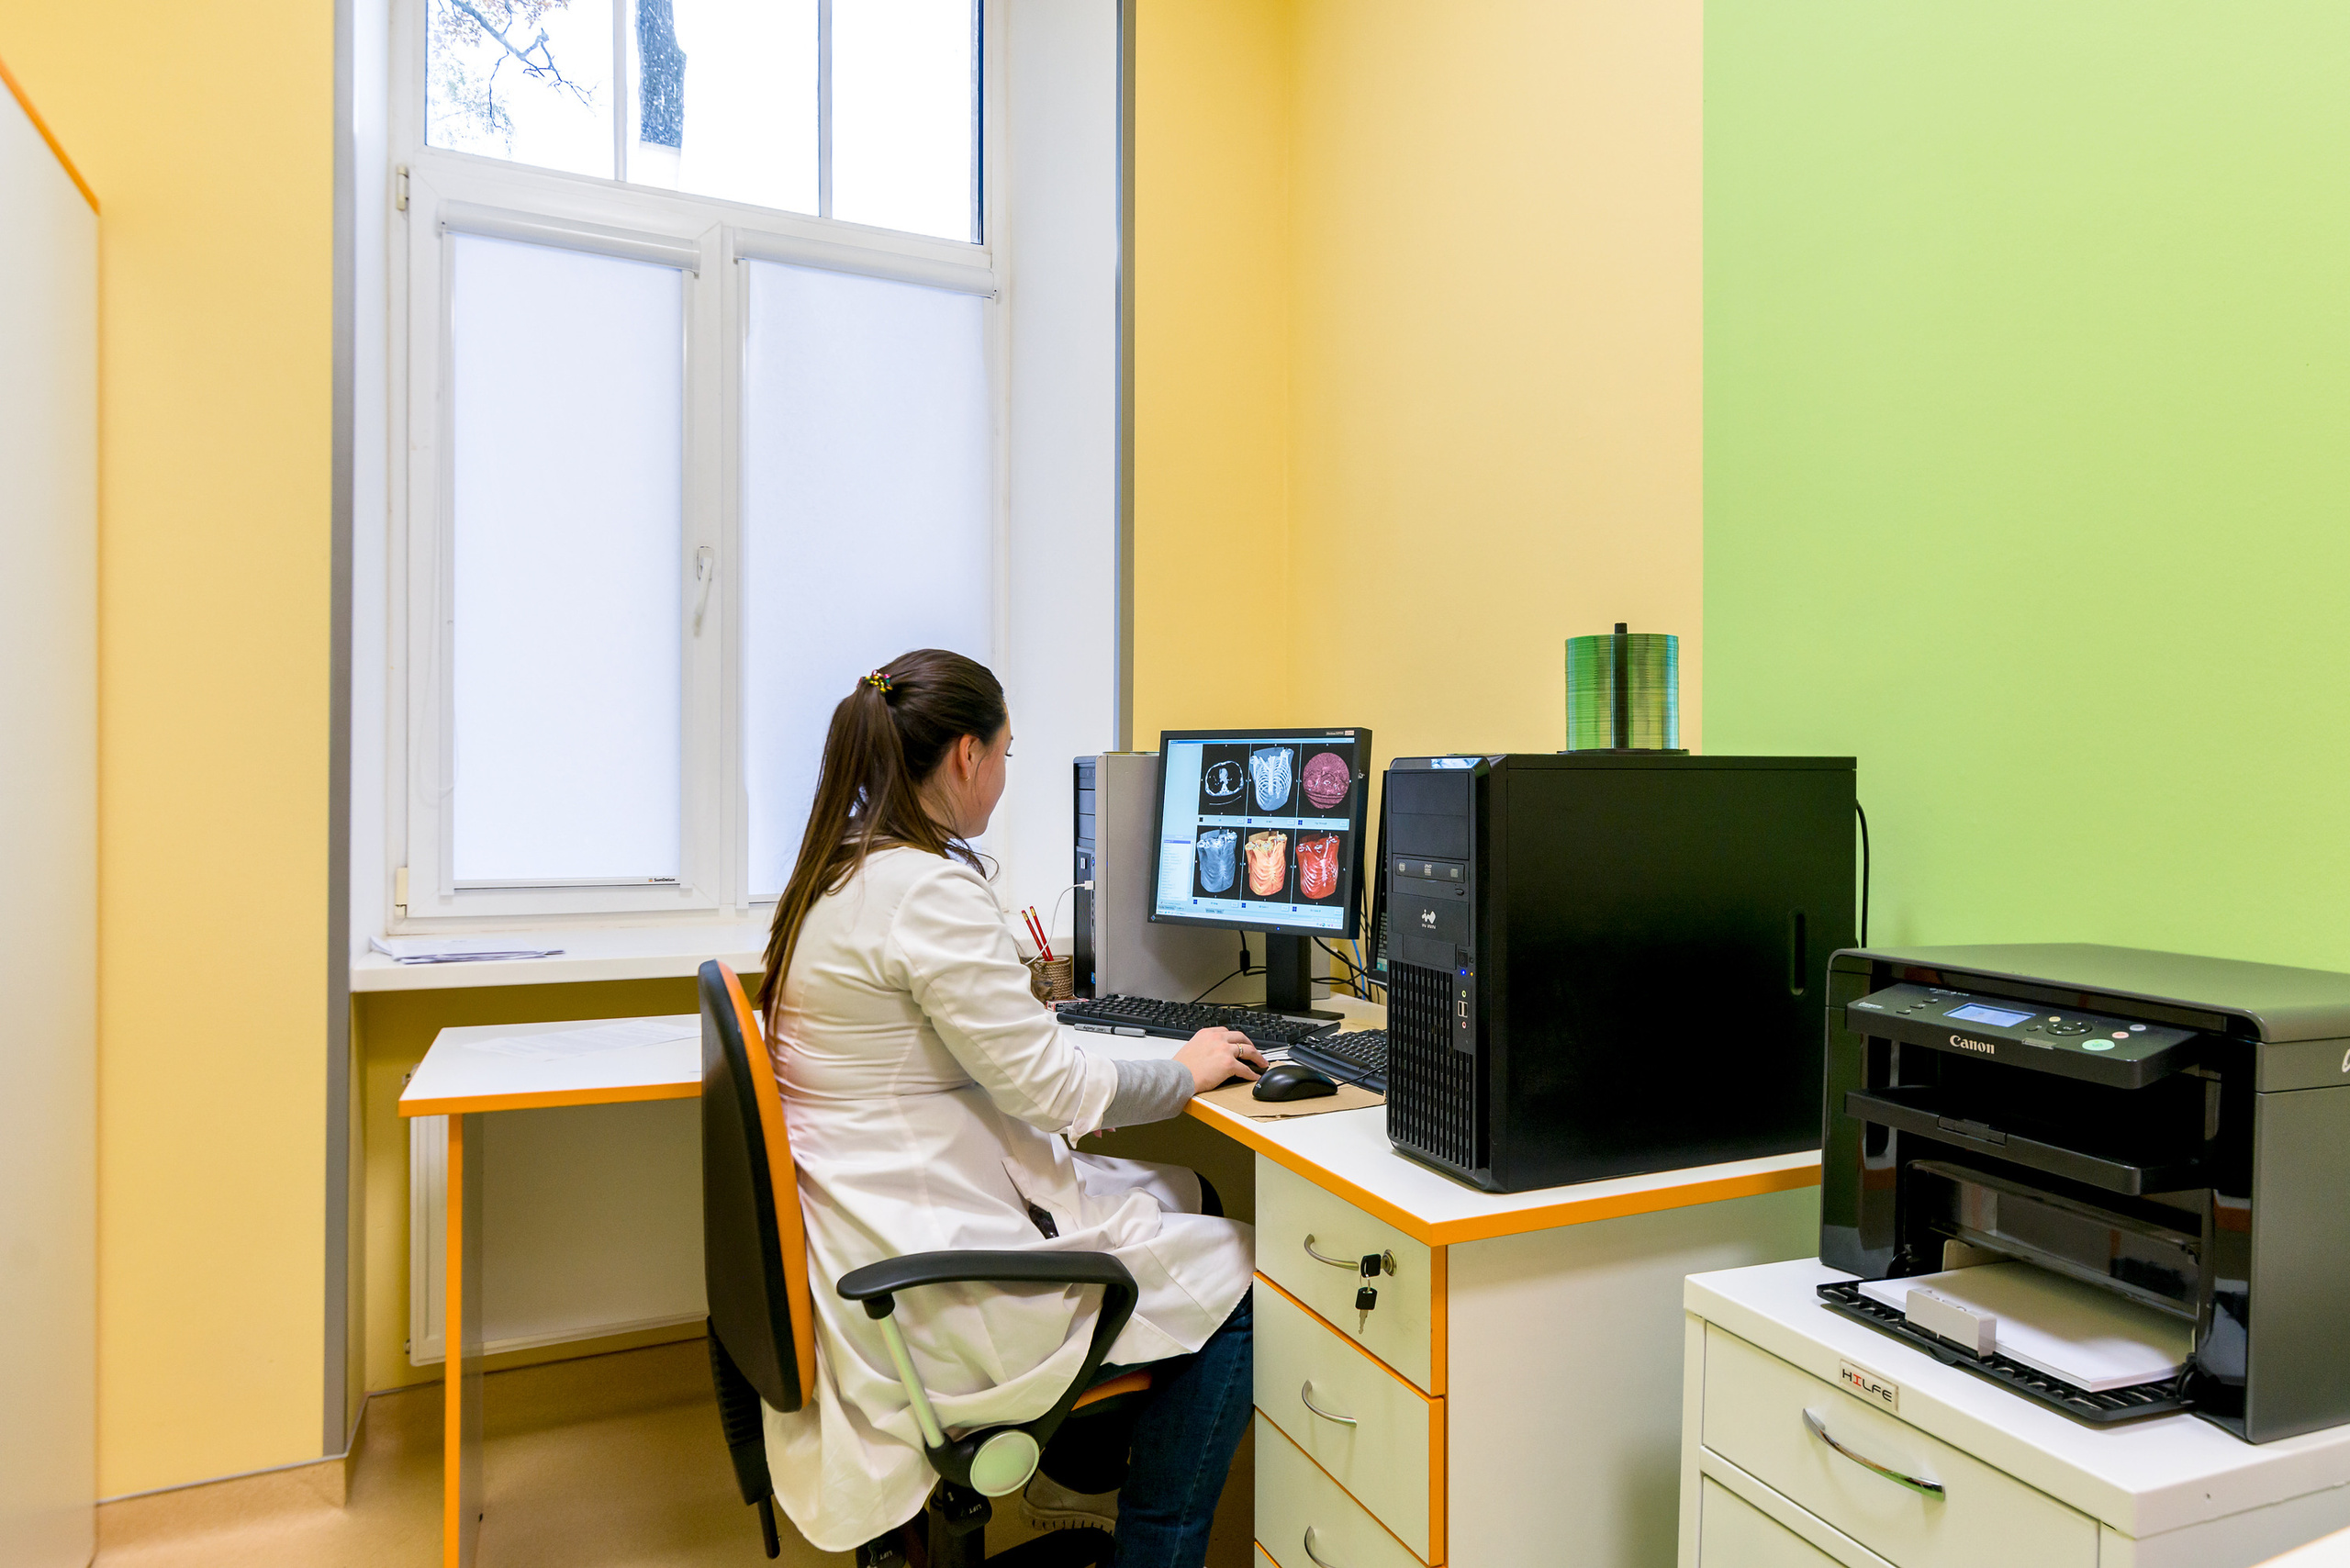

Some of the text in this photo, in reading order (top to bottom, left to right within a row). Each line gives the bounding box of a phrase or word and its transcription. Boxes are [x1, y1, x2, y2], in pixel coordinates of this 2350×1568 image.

[1949, 1035, 1995, 1055] Canon
[1841, 1368, 1893, 1403] HILFE
[968, 1504, 982, 1514] LIFT
[879, 1550, 893, 1560] LIFT
